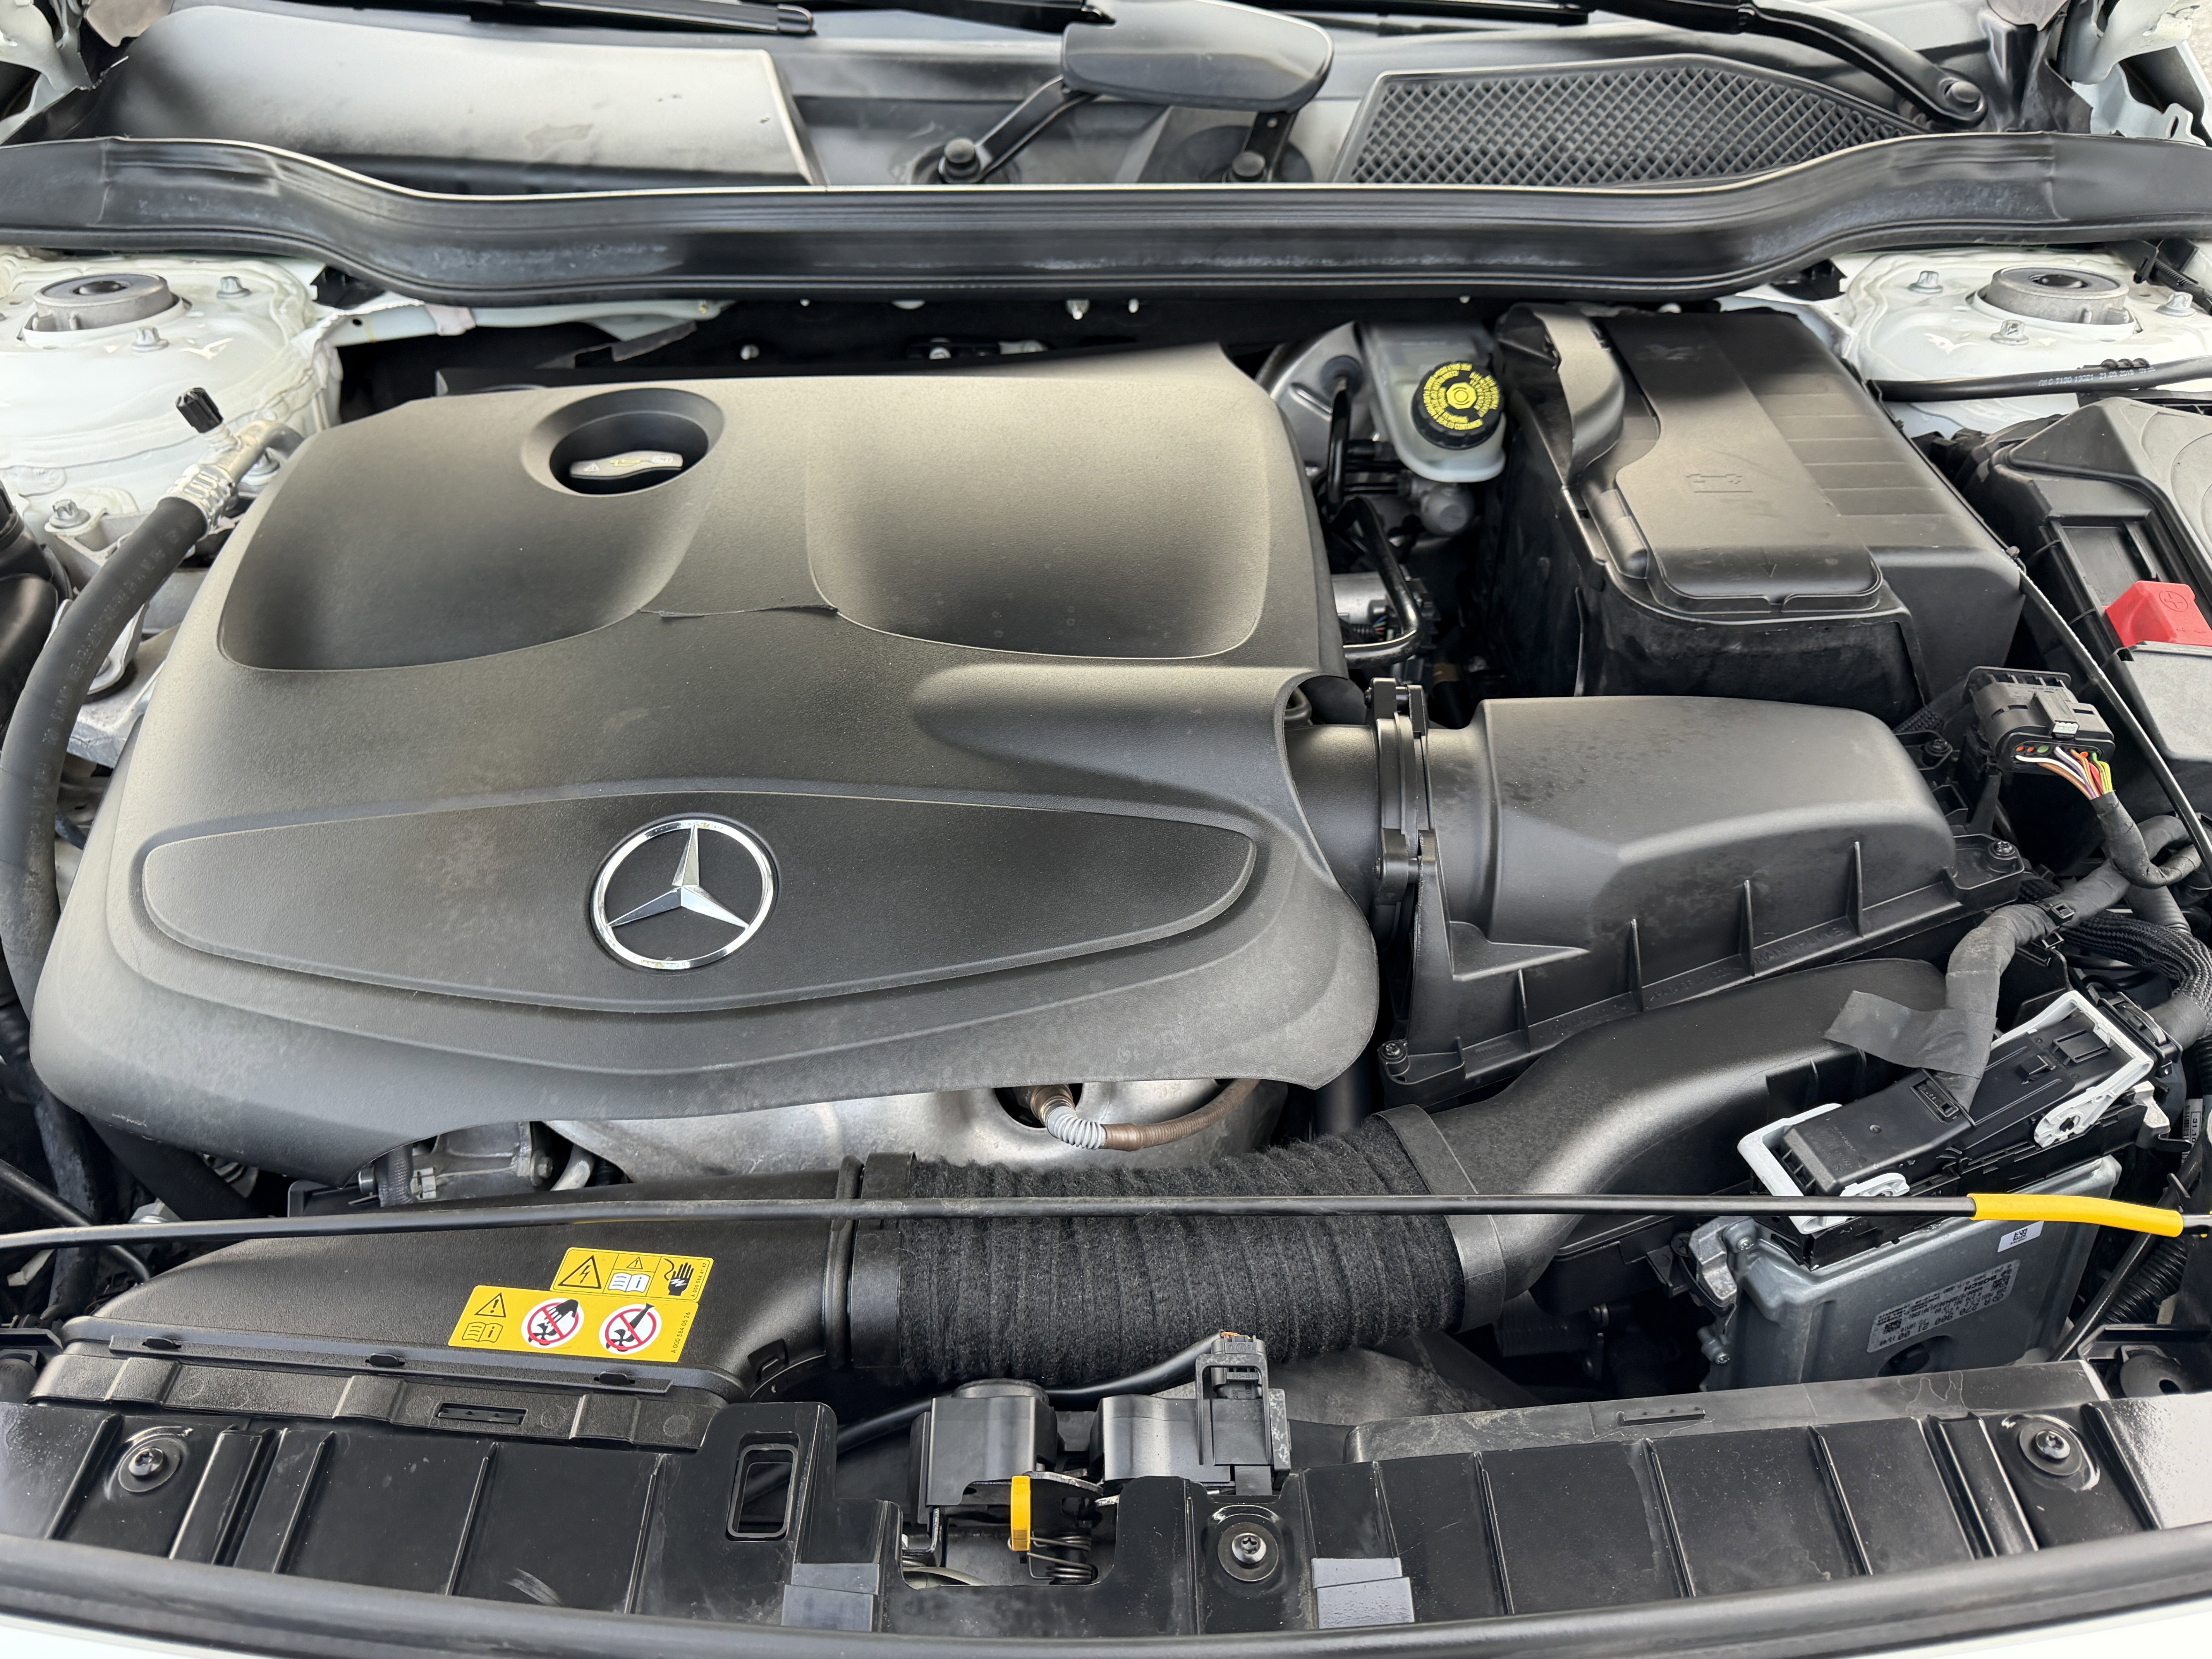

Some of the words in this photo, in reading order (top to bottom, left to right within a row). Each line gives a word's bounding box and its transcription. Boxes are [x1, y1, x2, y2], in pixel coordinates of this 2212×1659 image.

[1963, 1274, 1997, 1292] BOSCH
[1959, 1302, 1978, 1316] 270
[1934, 1312, 1954, 1326] 900
[1917, 1322, 1929, 1333] 21
[1897, 1329, 1911, 1341] 00
